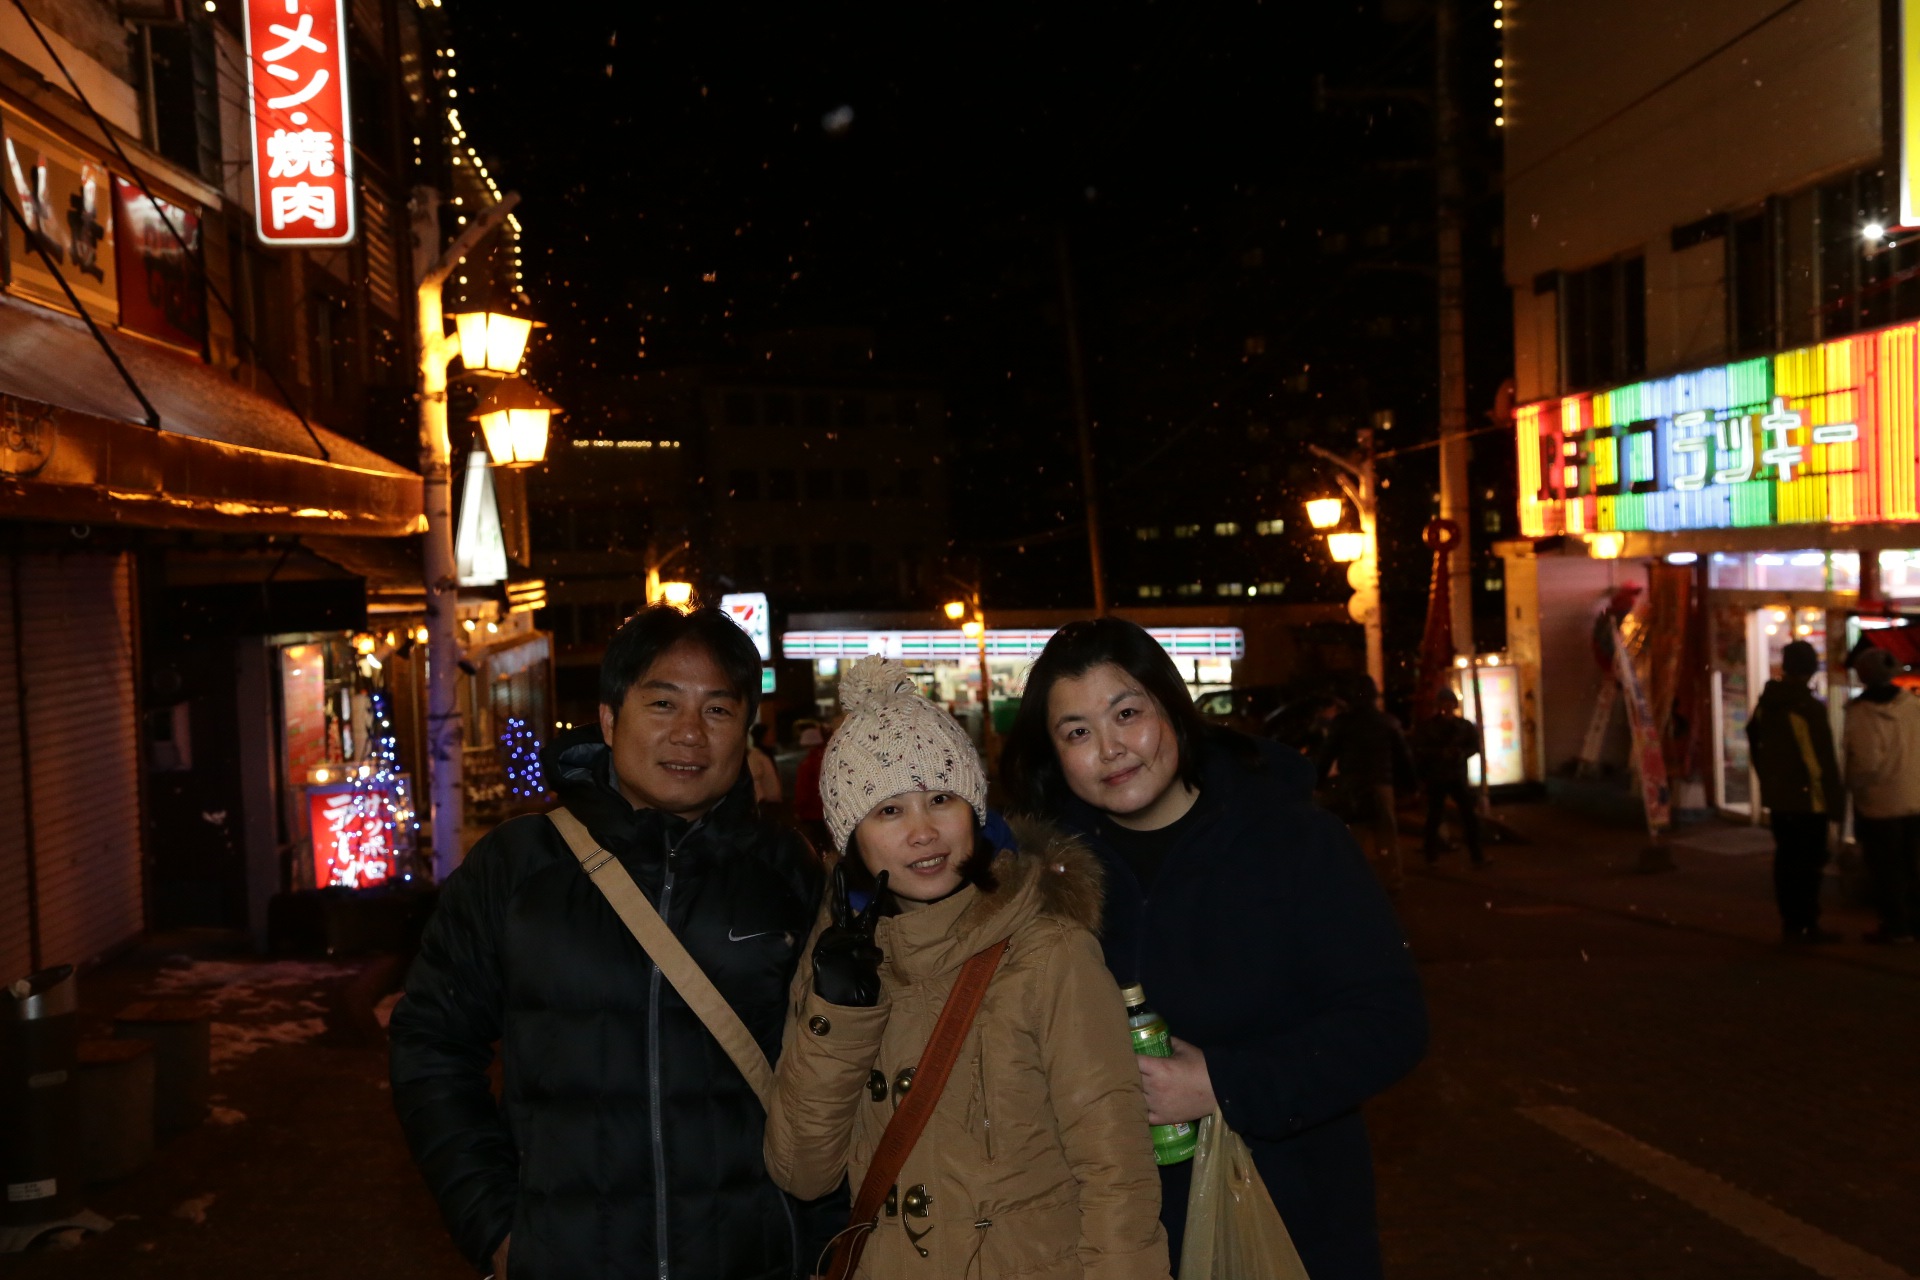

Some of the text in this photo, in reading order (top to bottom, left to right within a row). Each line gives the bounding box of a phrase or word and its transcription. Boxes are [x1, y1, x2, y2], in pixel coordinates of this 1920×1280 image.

[262, 0, 336, 230] メン・焼肉
